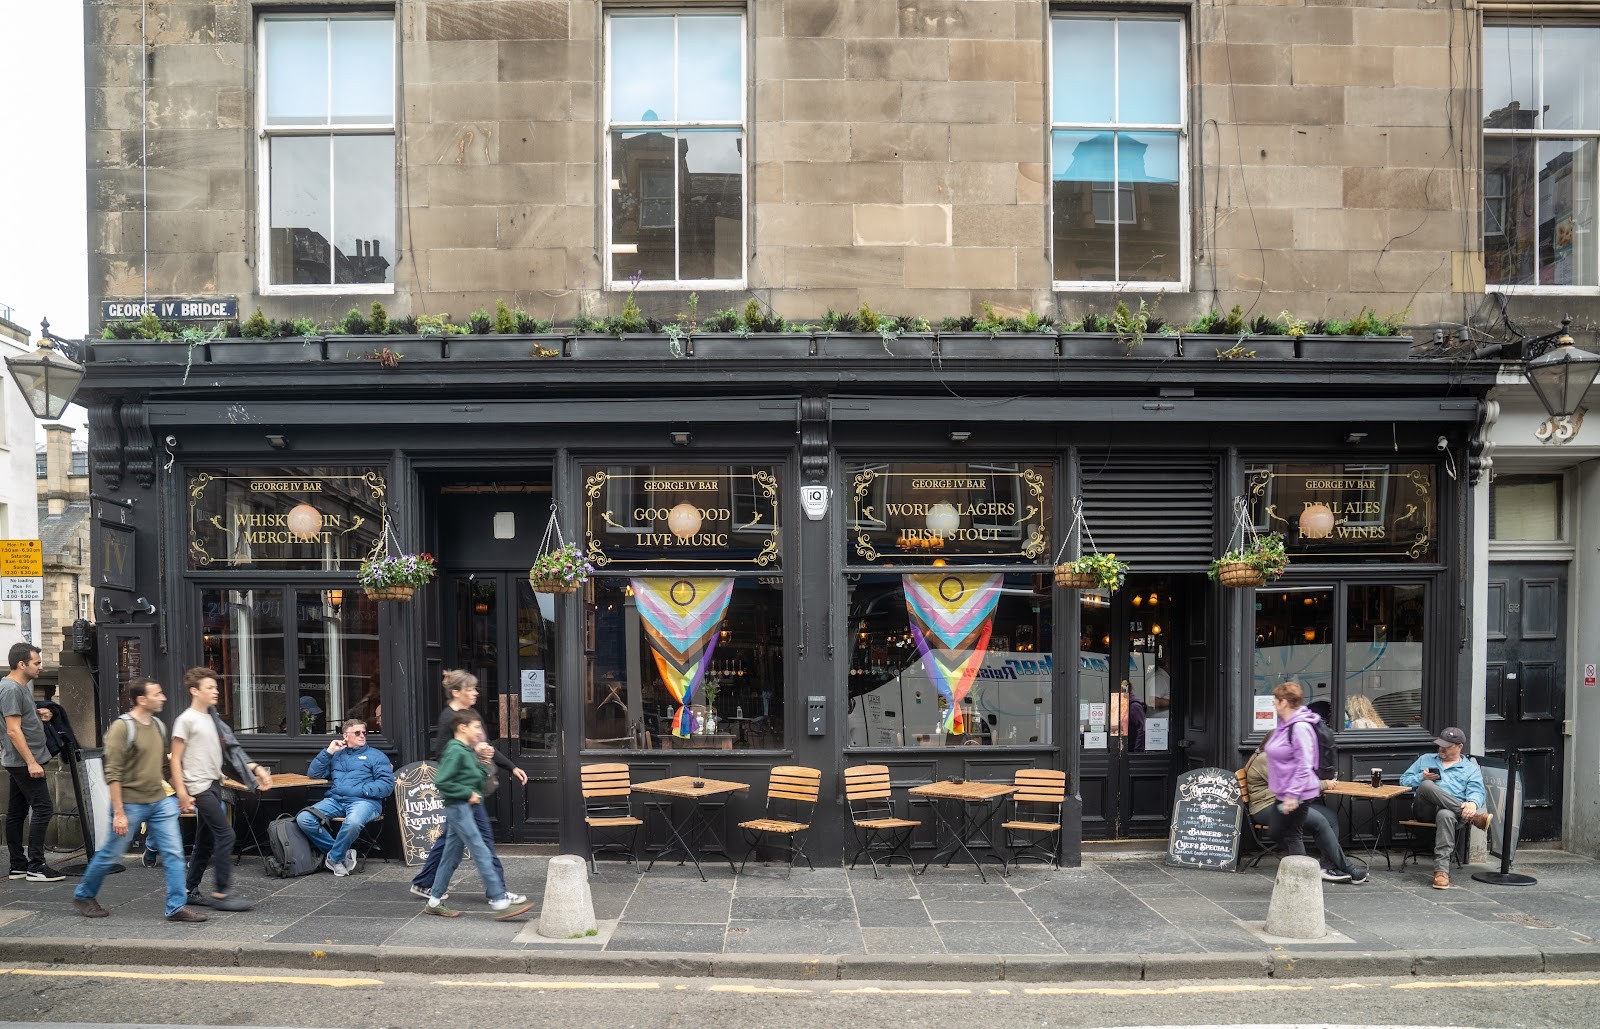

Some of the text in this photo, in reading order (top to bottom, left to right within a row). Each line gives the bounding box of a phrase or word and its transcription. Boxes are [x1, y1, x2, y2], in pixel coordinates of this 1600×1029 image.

[108, 303, 157, 317] GEORGE
[250, 482, 322, 491] GEORGE IV BAR
[643, 481, 719, 491] GEORGE IV BAR
[911, 479, 986, 489] GEORGE IV BAR
[1305, 480, 1376, 489] GEORGE IV BAR
[809, 491, 822, 501] iQ
[957, 502, 1015, 516] LAGERS
[1344, 501, 1381, 514] ALES
[633, 508, 682, 521] GOOD
[1334, 515, 1349, 526] and
[243, 531, 332, 545] MERCHANT
[900, 528, 1002, 541] IRISH STOUT
[1298, 526, 1386, 539] FINE WINES
[636, 533, 728, 546] LIVE MUSIC
[1192, 784, 1229, 799] Specials
[423, 796, 446, 811] MUS
[404, 813, 448, 830] EVERY NIG
[1188, 827, 1222, 838] BANGERS
[1199, 842, 1231, 853] SPECIAL
